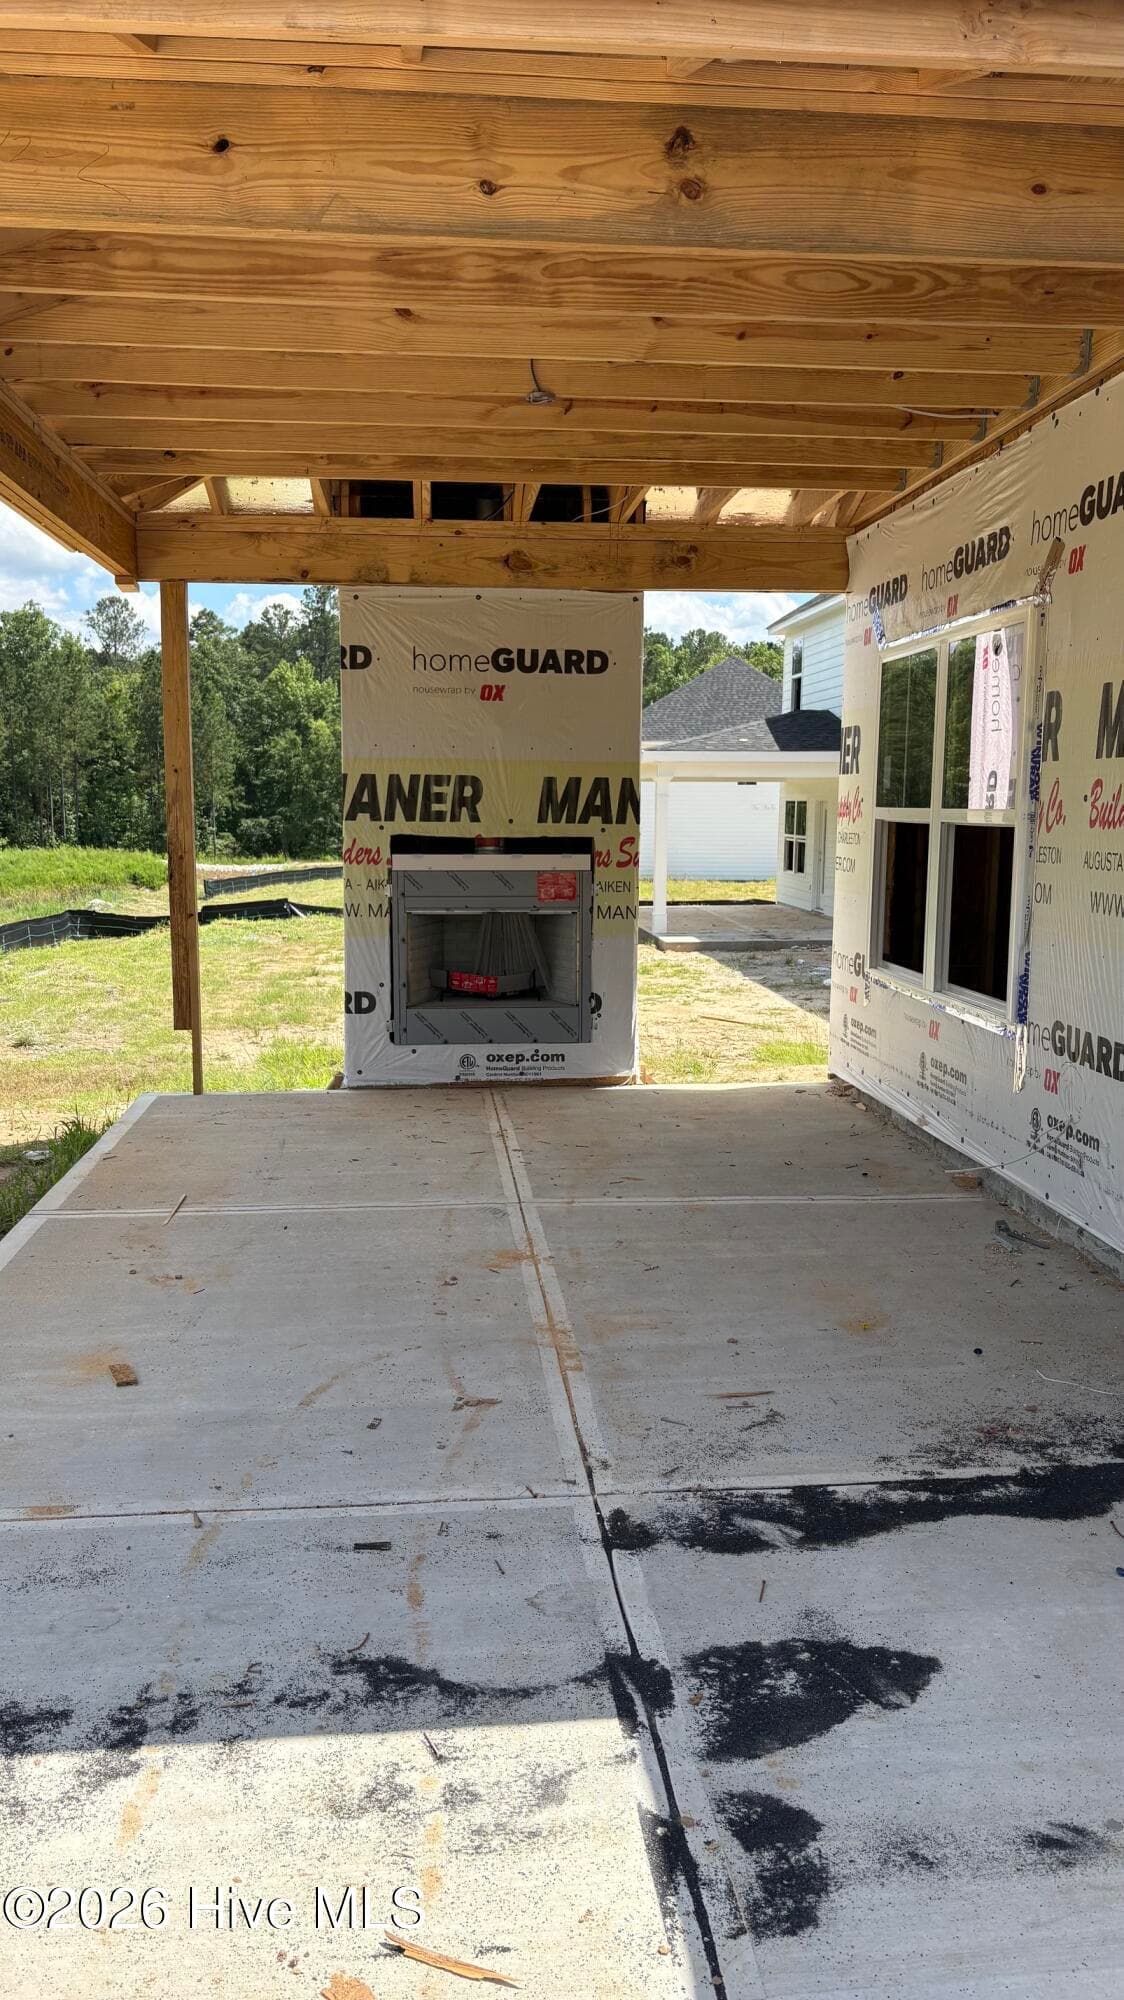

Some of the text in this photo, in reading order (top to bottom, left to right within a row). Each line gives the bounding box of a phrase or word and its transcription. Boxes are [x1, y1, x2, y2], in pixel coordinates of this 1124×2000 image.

[921, 526, 1011, 592] homeGUARD
[1068, 544, 1087, 575] OX
[412, 646, 609, 674] homeGUARD
[479, 684, 506, 702] OX
[343, 774, 483, 823] ANER
[486, 1053, 566, 1064] oxep.com
[930, 1057, 968, 1086] oxep.com
[1044, 1068, 1061, 1095] OX
